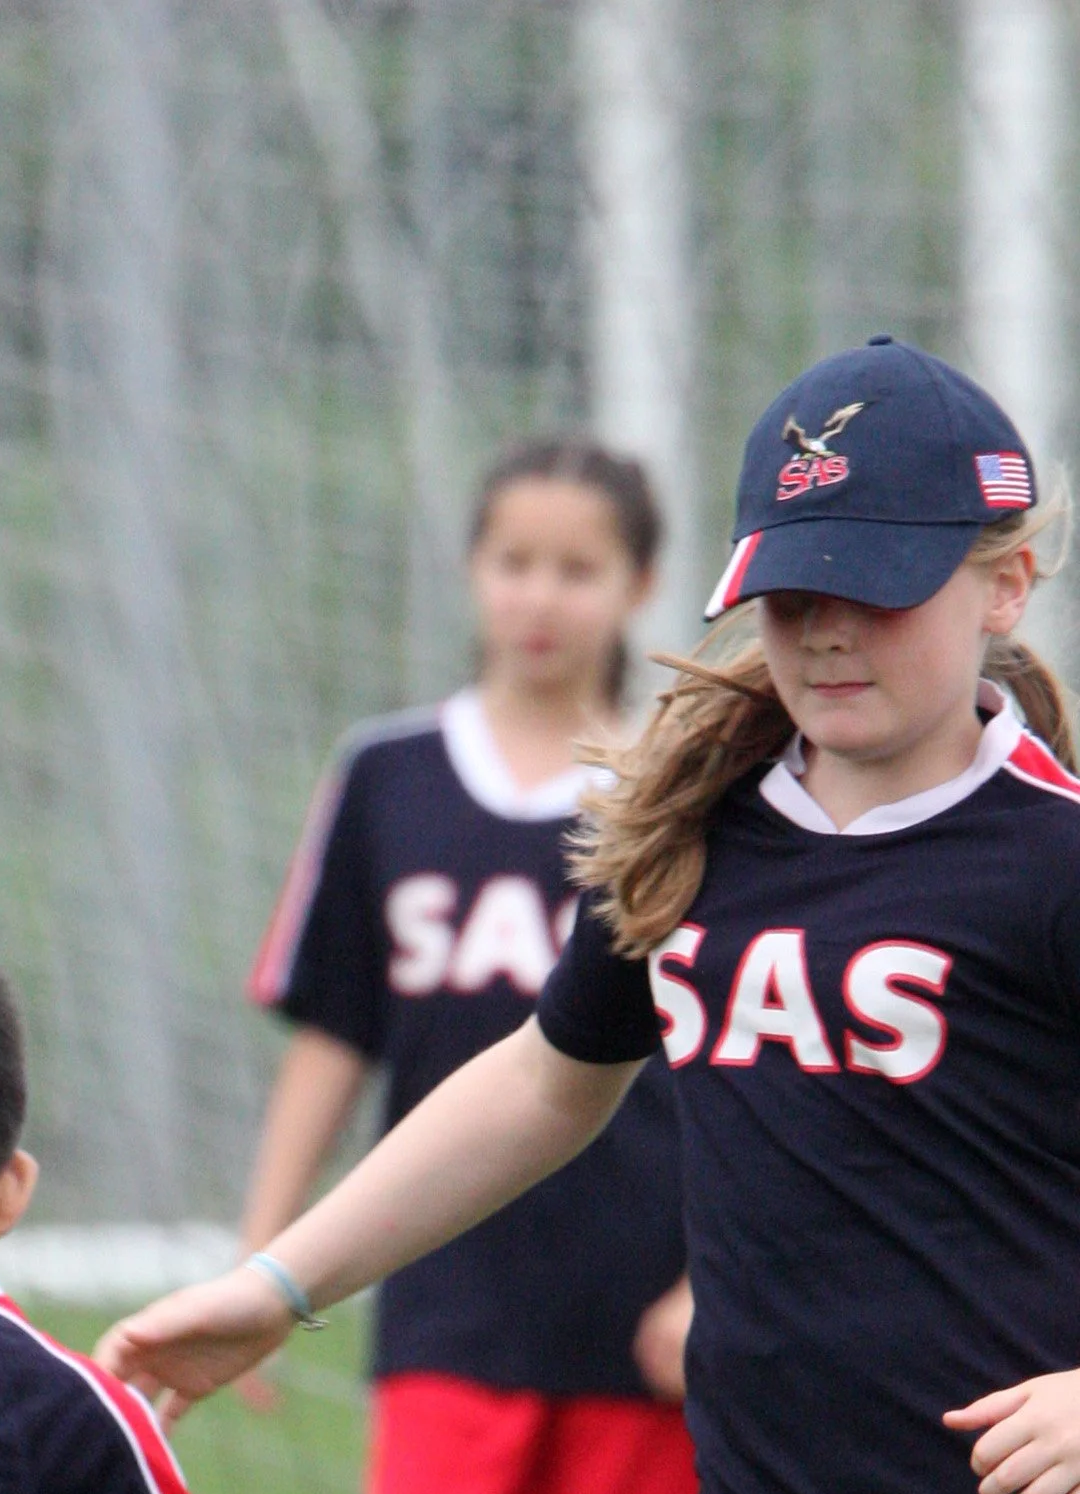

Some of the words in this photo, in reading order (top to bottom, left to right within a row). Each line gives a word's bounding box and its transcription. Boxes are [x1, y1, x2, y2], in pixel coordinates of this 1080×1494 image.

[776, 455, 850, 501] SAS
[383, 870, 580, 998] SA
[647, 920, 954, 1086] SAS
